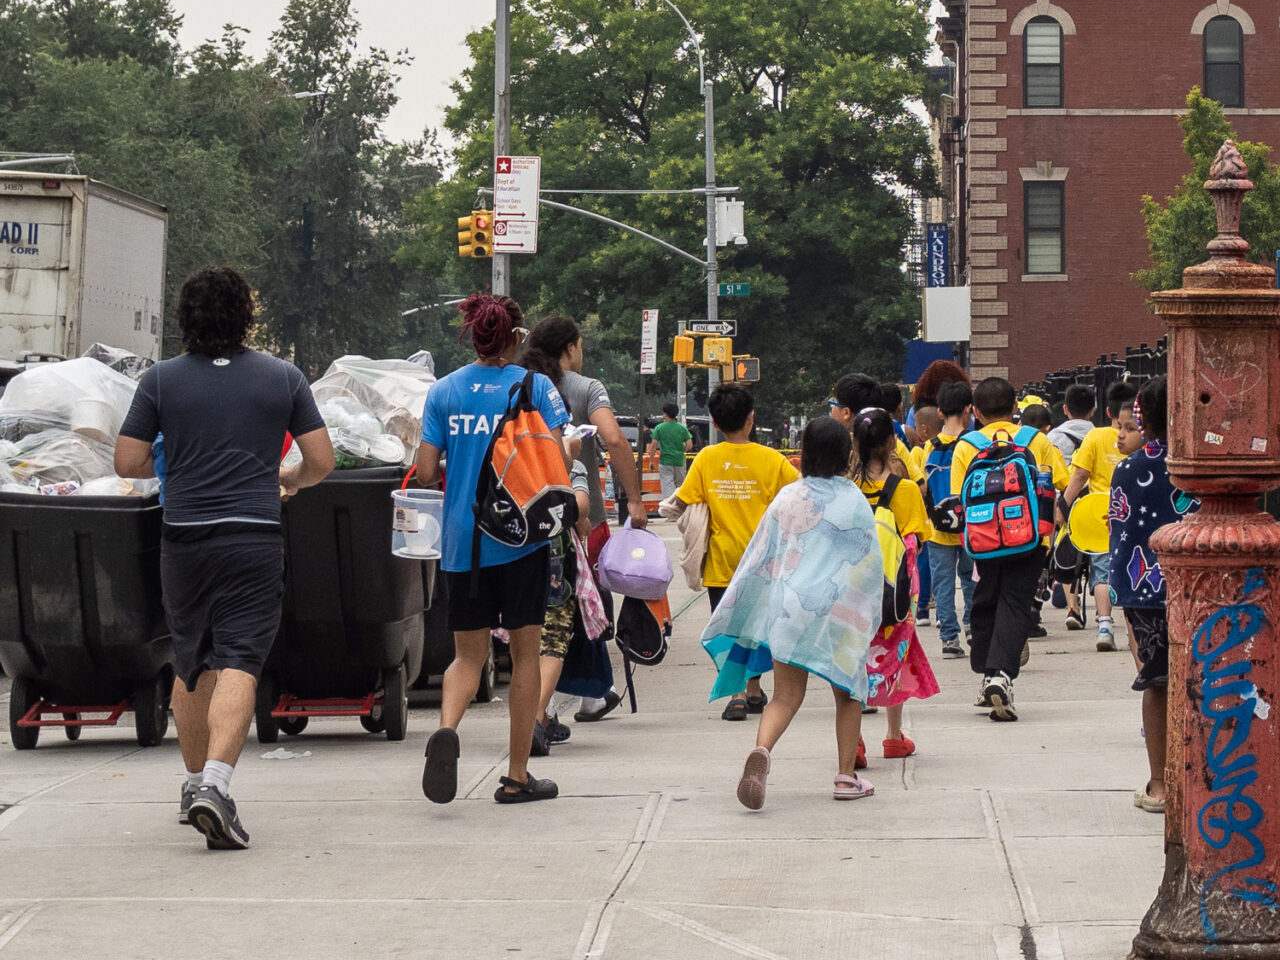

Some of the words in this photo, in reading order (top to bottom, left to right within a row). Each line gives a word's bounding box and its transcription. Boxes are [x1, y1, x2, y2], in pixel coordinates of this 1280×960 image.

[10, 247, 39, 255] CORP.
[932, 231, 945, 288] LAUNDROM
[727, 285, 734, 295] 51
[715, 324, 729, 332] WAY
[539, 522, 551, 530] the
